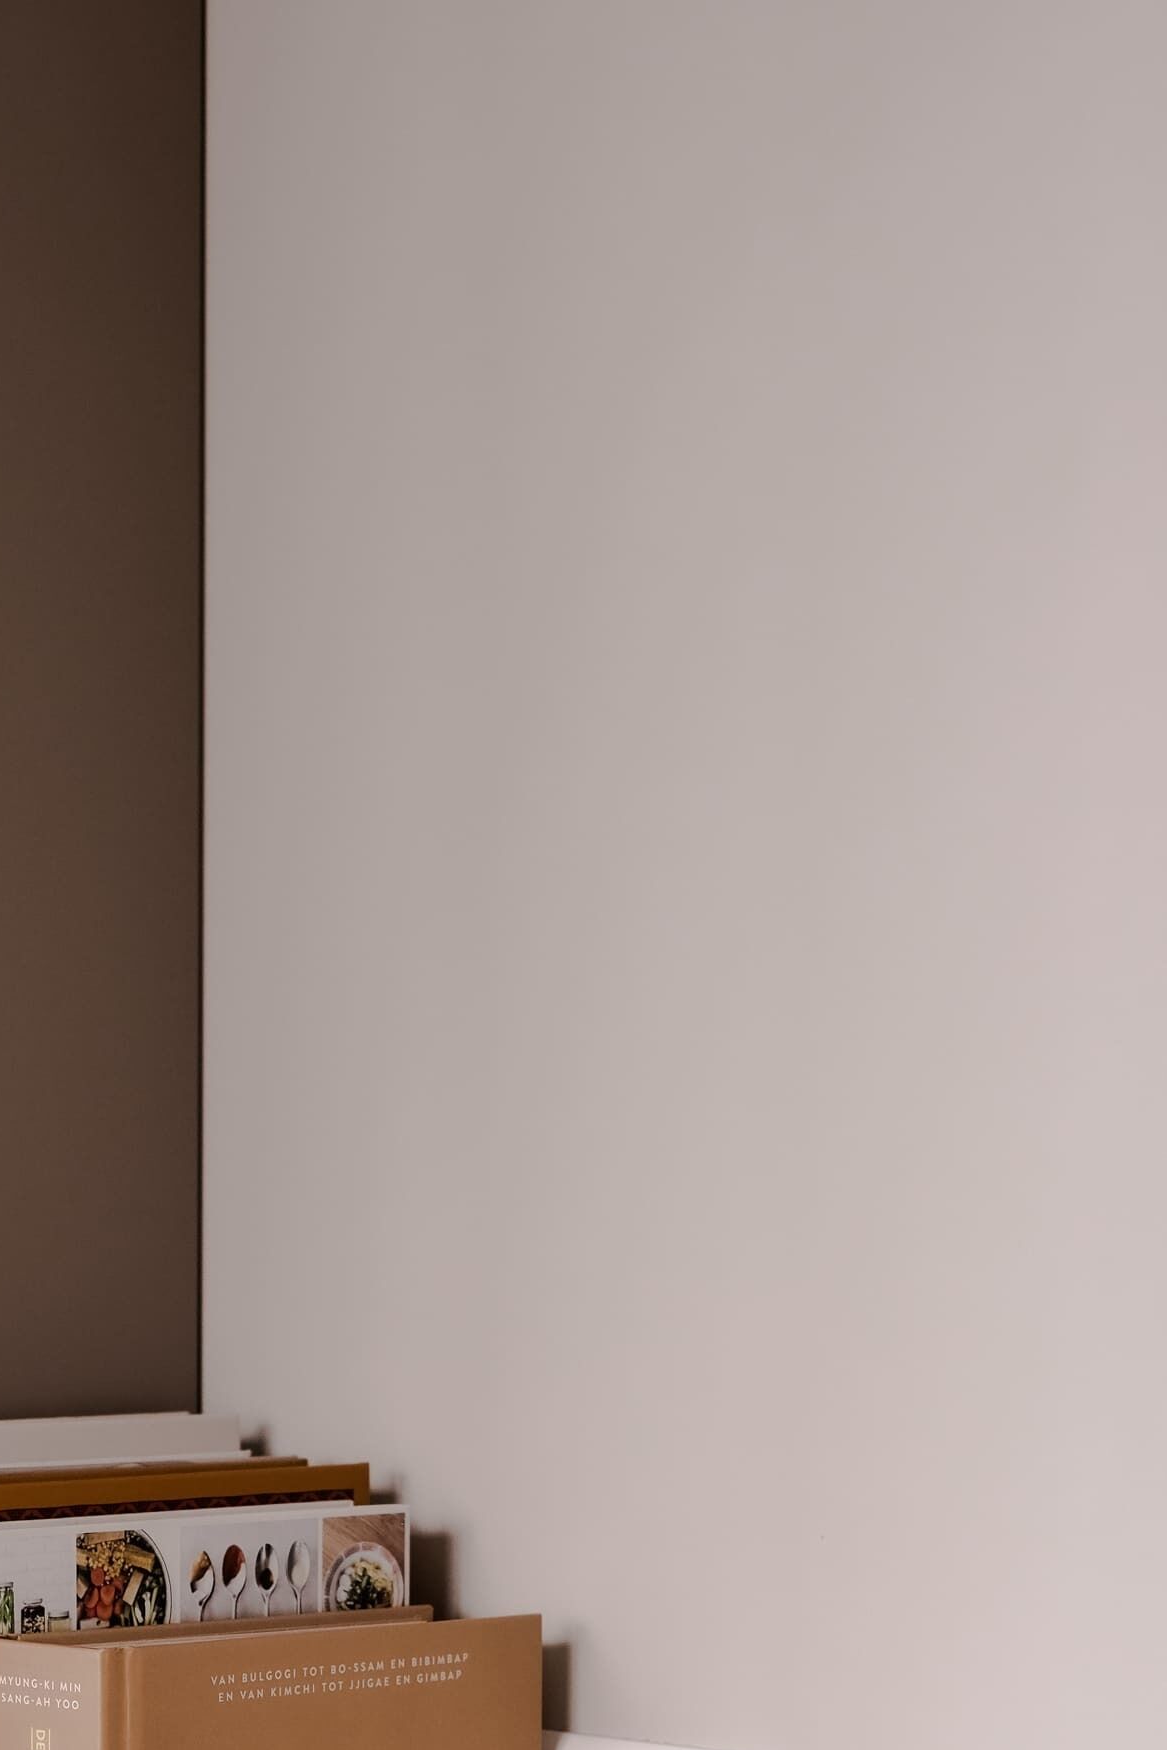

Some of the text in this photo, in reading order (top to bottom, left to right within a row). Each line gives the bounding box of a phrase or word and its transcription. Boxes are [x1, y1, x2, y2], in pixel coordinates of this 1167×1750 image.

[211, 1653, 469, 1686] VAN BULGOGI TOT BO-SSAM EN BIBIMBAP
[0, 1675, 81, 1693] MYUNG-KI MIN
[218, 1670, 462, 1702] EN VAN KIMCHI TOT JJIGAE EN GIMBAP
[1, 1692, 80, 1710] SANG-AH YOO
[36, 1729, 46, 1750] DE
